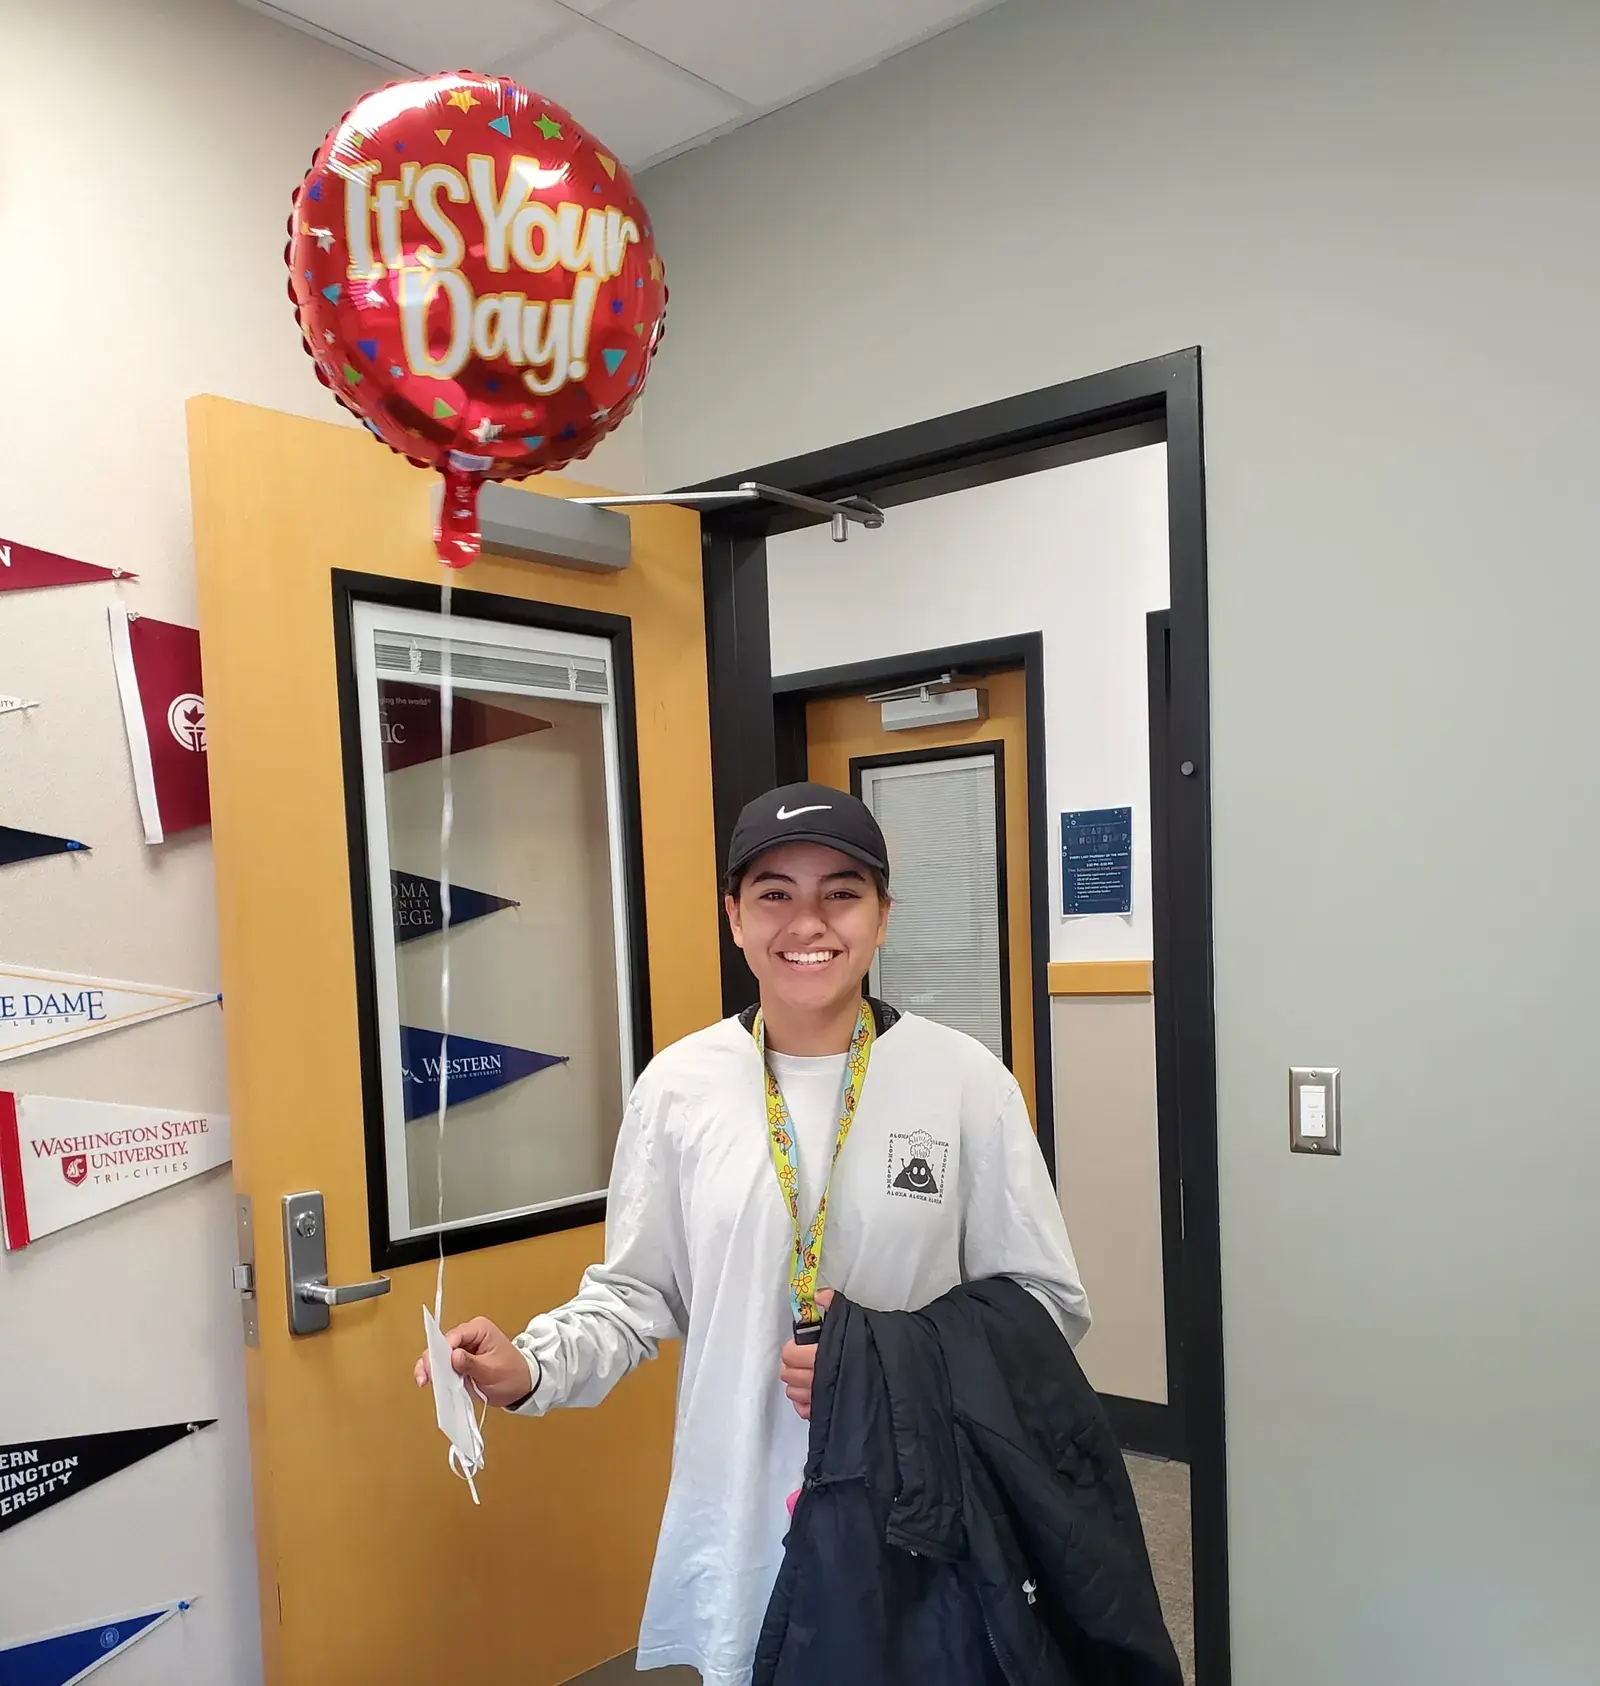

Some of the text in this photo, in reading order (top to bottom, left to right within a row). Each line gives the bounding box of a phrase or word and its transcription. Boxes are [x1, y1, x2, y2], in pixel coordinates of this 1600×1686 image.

[467, 153, 640, 284] Your
[399, 266, 602, 396] Day!
[23, 990, 108, 1022] DAME
[30, 1118, 210, 1158] WASHINGTON STATE
[94, 1161, 190, 1185] TRI-CITIES
[0, 1449, 39, 1470] ERN
[0, 1471, 73, 1517] ERSITY
